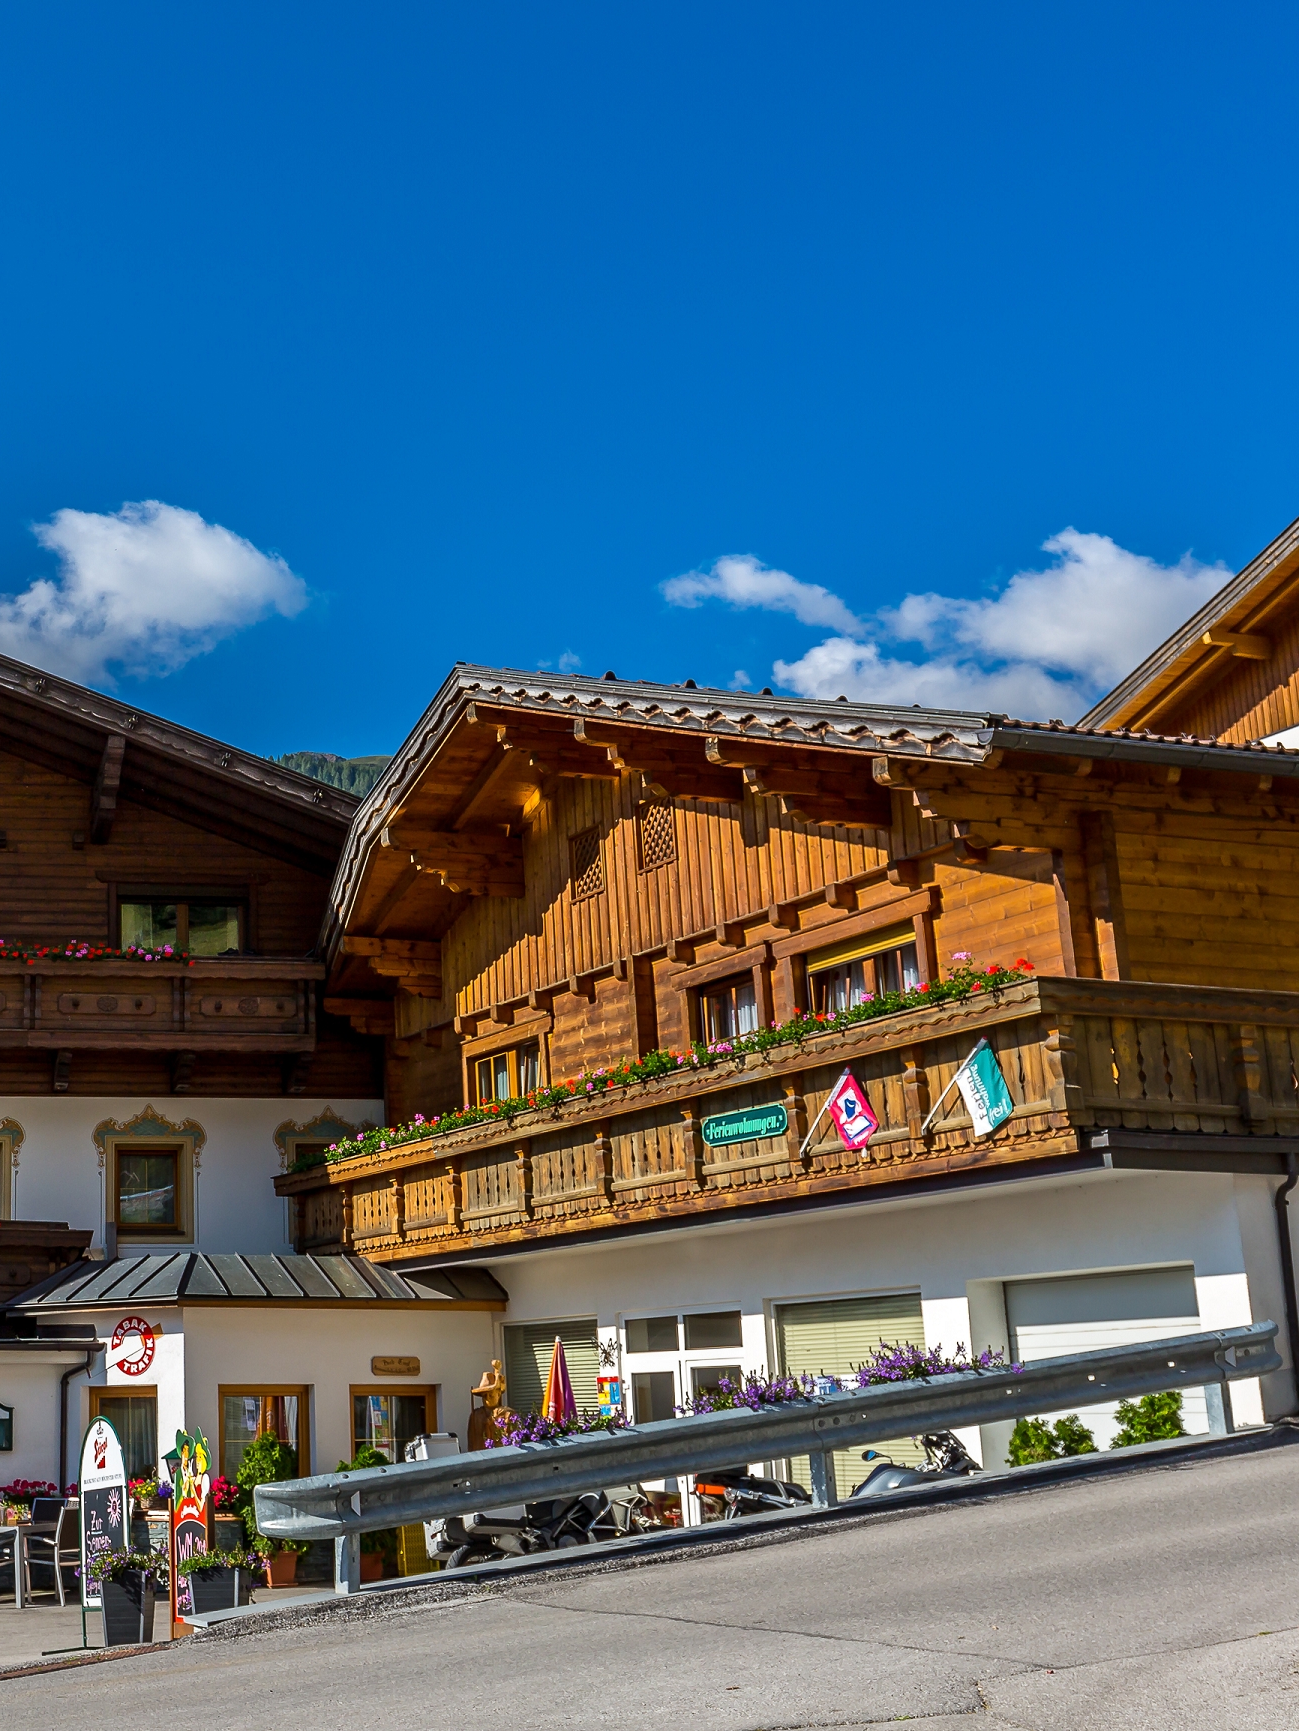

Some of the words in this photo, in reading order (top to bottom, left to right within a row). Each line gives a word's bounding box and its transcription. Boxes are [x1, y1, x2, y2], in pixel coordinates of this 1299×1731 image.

[112, 1318, 147, 1346] TABAK
[123, 1337, 154, 1373] TRAFIK
[90, 1510, 103, 1531] Zur
